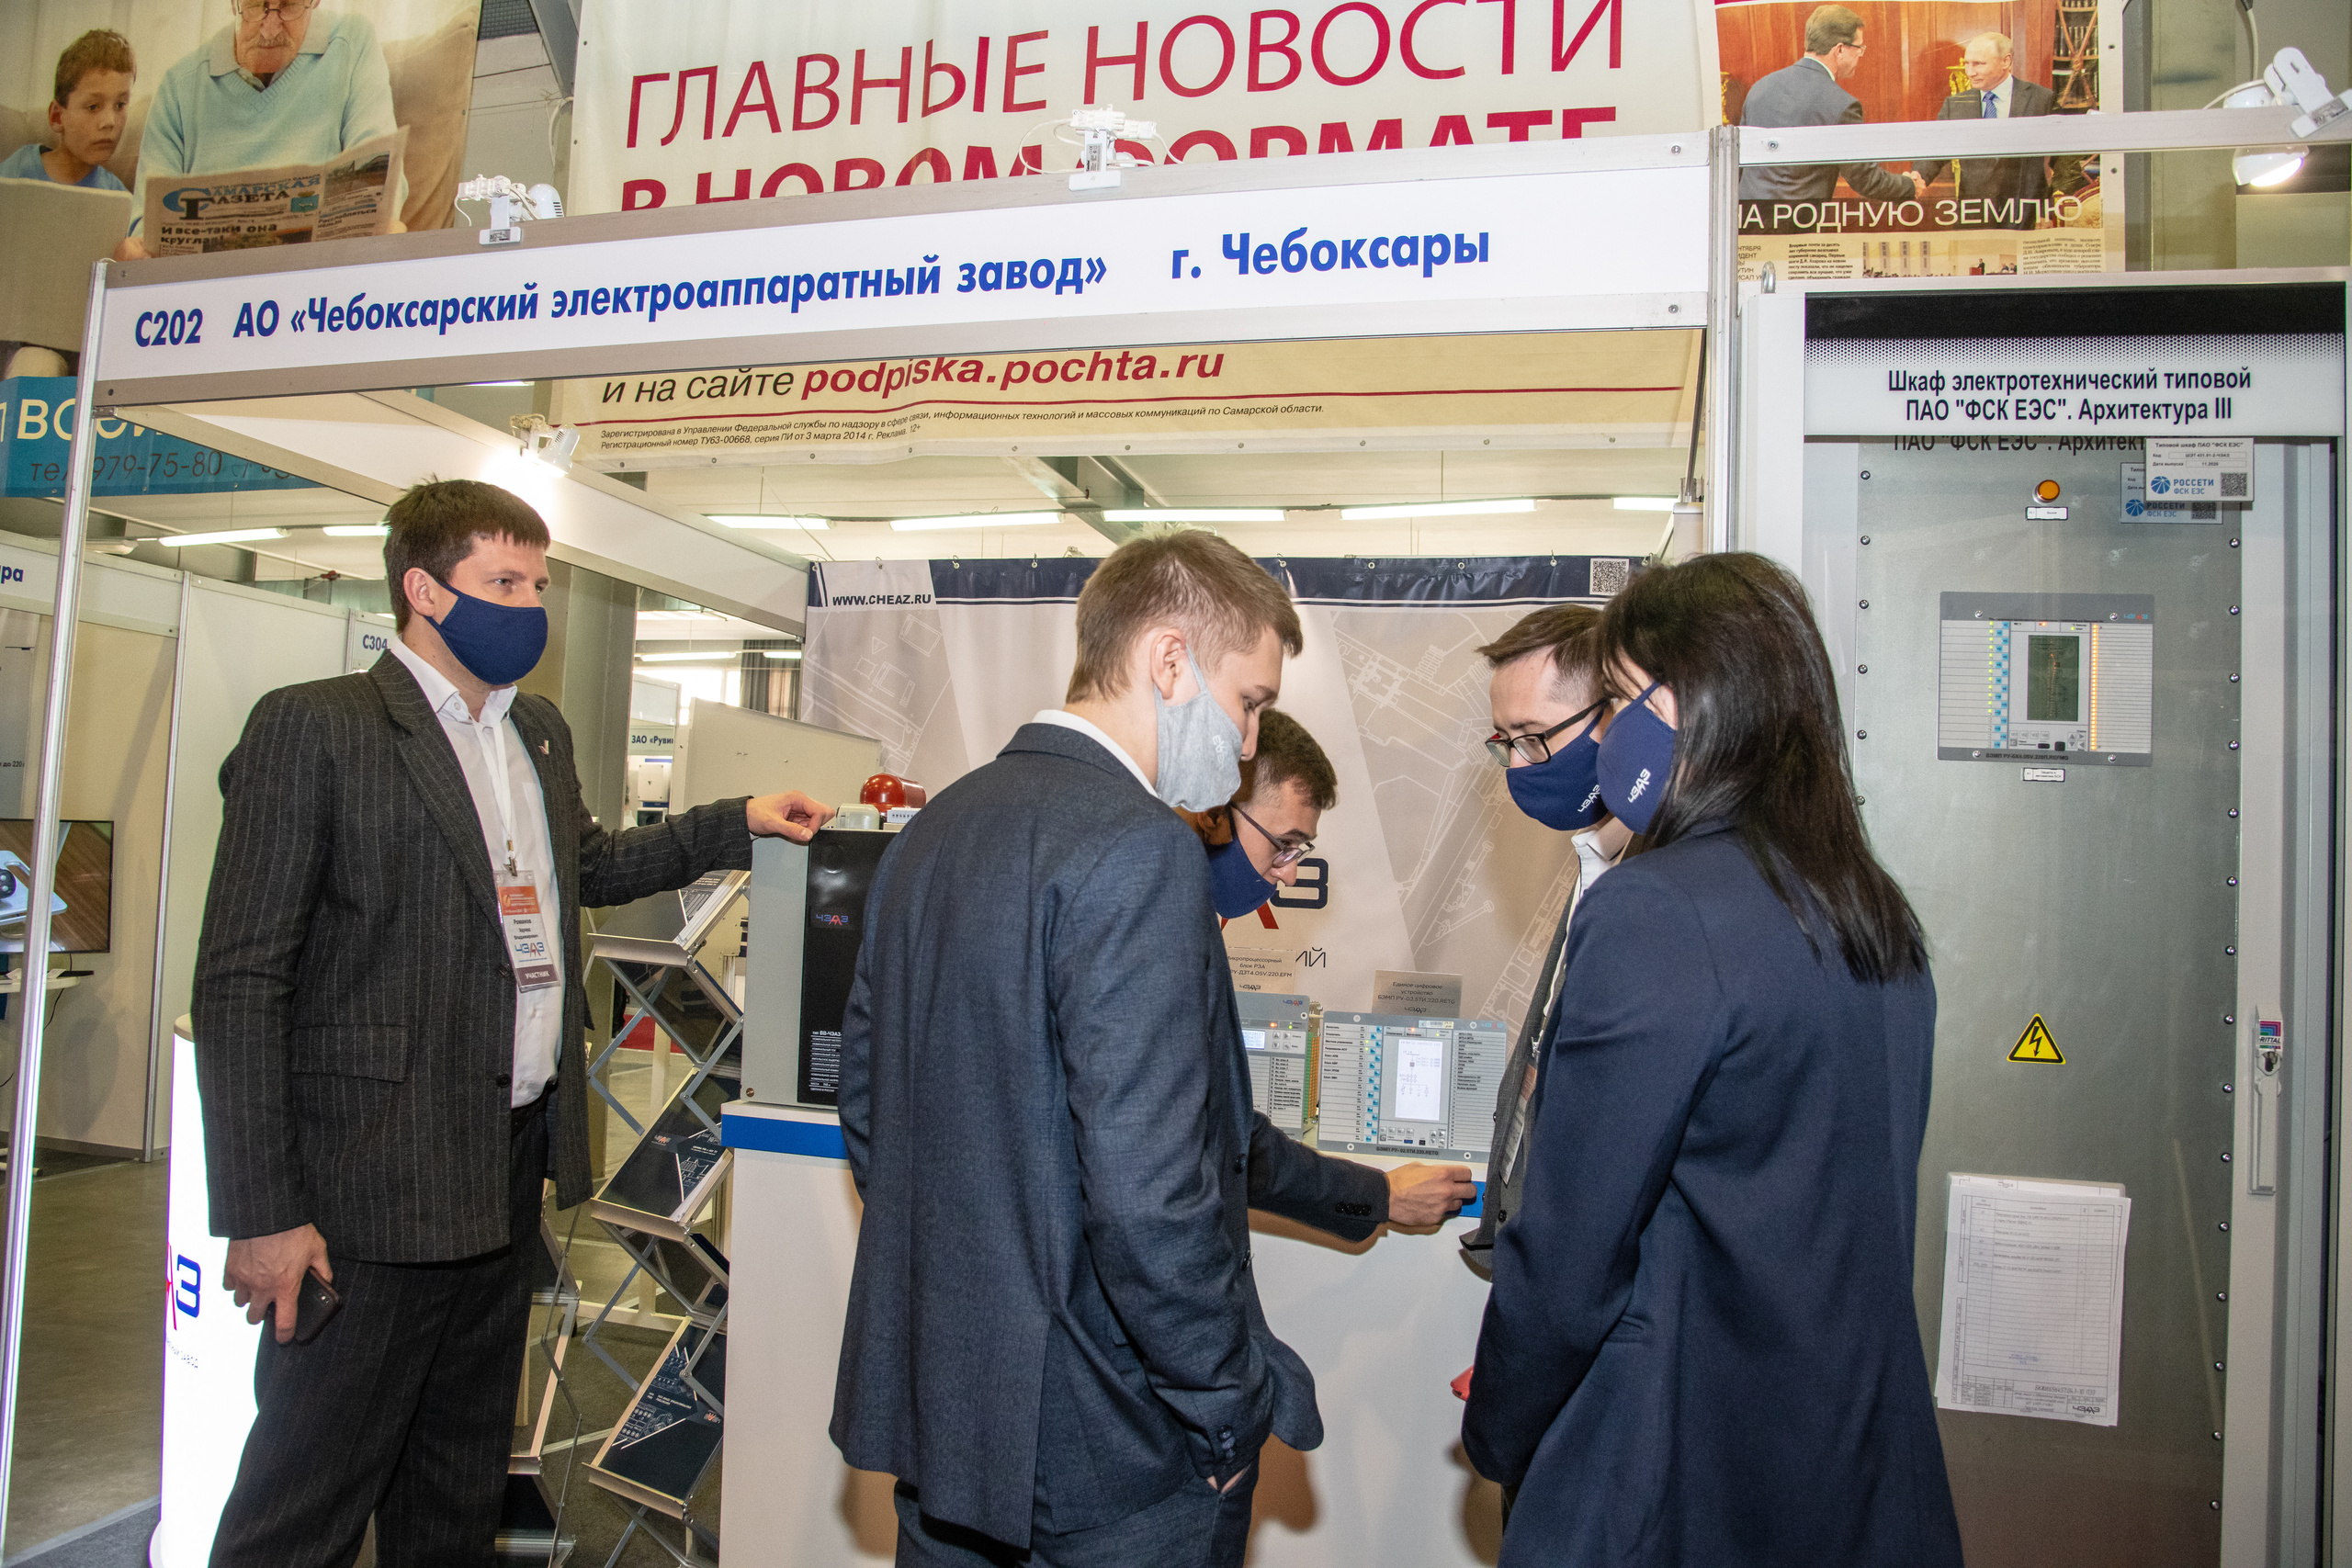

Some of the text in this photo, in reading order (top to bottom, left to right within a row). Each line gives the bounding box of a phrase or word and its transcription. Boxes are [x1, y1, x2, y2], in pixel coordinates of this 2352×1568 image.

[626, 29, 1049, 149] ГЛАВНЫЕ
[1083, 0, 1623, 106] НОВОСТИ
[246, 223, 277, 233] она
[1773, 200, 1925, 234] РОДНУЮ
[1934, 195, 2084, 226] ЗЕМЛЮ
[135, 227, 1490, 347] С202 АО «Чебоксарский электроаппаратный завод» г. Чебоксары
[601, 351, 1225, 404] и на сайте podpiska.pochta.ru
[1888, 366, 2251, 394] Шкаф электротехнический типовой
[601, 429, 675, 440] Зарегистрирована
[683, 425, 732, 435] Управлении
[734, 421, 792, 434] Федеральной
[793, 420, 827, 431] службы
[829, 421, 840, 429] по
[842, 421, 880, 432] надзору
[887, 416, 908, 429] сфере
[909, 412, 931, 423] связи,
[933, 410, 1020, 422] информационных
[1022, 410, 1076, 421] технологий
[1085, 411, 1133, 420] массовых
[1135, 406, 1205, 419] коммуникаций
[1208, 409, 1220, 418] по
[1222, 404, 1278, 417] Самарской
[1280, 404, 1324, 415] области.
[1905, 396, 2232, 425] ПАО "ФСК ЕЭС". Архитектура III
[601, 438, 672, 450] Регистрационный
[673, 438, 698, 447] номер
[700, 434, 752, 446] ТУ63-00668,
[754, 434, 779, 444] серия
[781, 434, 793, 442] ПИ
[813, 433, 841, 442] марта
[842, 432, 866, 441] 2014
[876, 428, 908, 440] Реклама.
[909, 424, 922, 434] 12+
[2173, 479, 2214, 487] РОССЕТИ
[0, 566, 24, 583] ра
[831, 592, 933, 606] WWW.CHEAZ.RU
[631, 735, 648, 744] ЗАО
